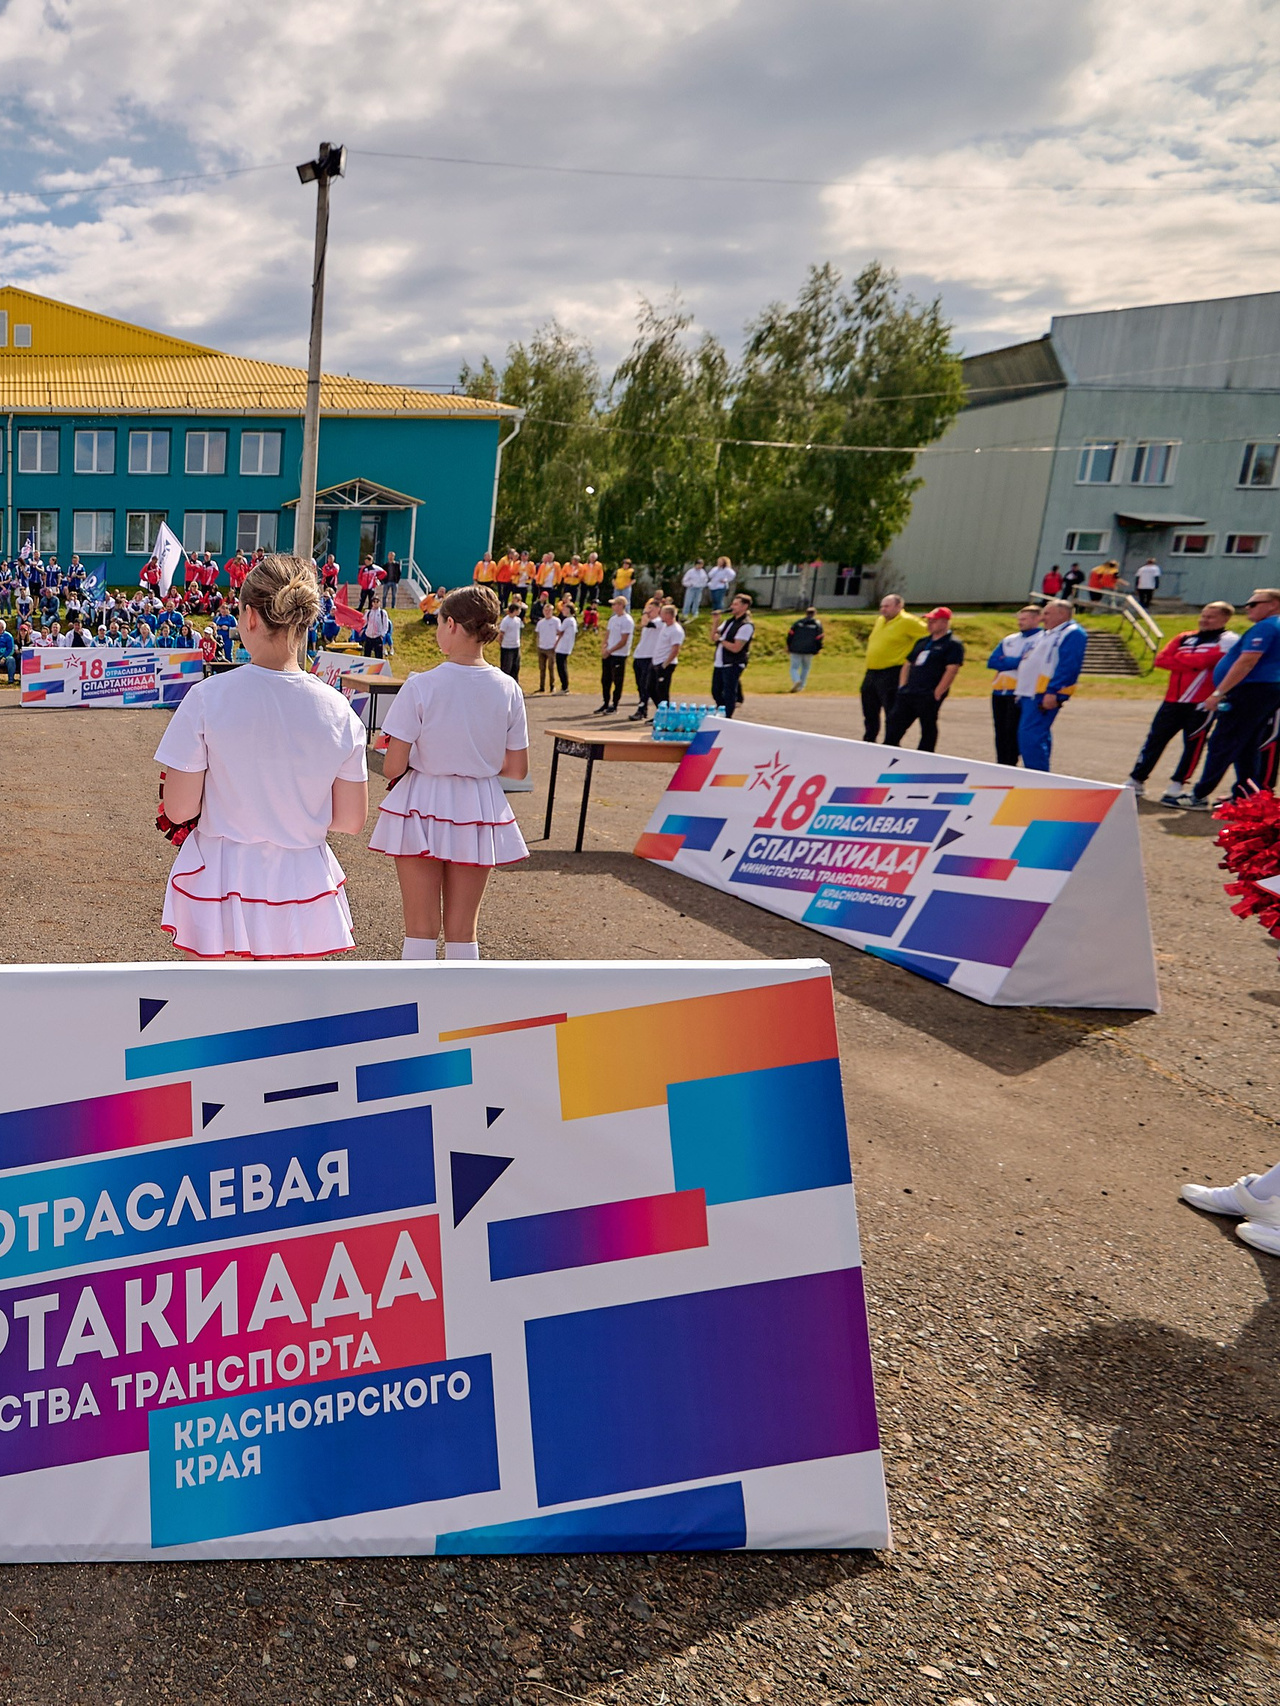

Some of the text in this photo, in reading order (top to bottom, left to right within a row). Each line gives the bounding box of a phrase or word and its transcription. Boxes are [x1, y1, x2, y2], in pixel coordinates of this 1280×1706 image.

[79, 658, 147, 681] 18 ОТРАСЛЕВАЯ
[83, 674, 155, 691] СПАРТАКИАДА
[753, 774, 920, 835] 18 ОТРАСЛЕВАЯ
[747, 837, 920, 875] СПАРТАКИАДА
[738, 862, 889, 890] МИНИСТЕРСТВА ТРАНСПОРТА
[815, 900, 842, 911] КРАЯ
[821, 888, 907, 909] КРАСНОЯРСКОГО
[111, 1331, 381, 1412] ТРАНСПОРТА
[173, 1370, 473, 1451] КРАСНОЯРСКОГО
[174, 1444, 263, 1489] КРАЯ
